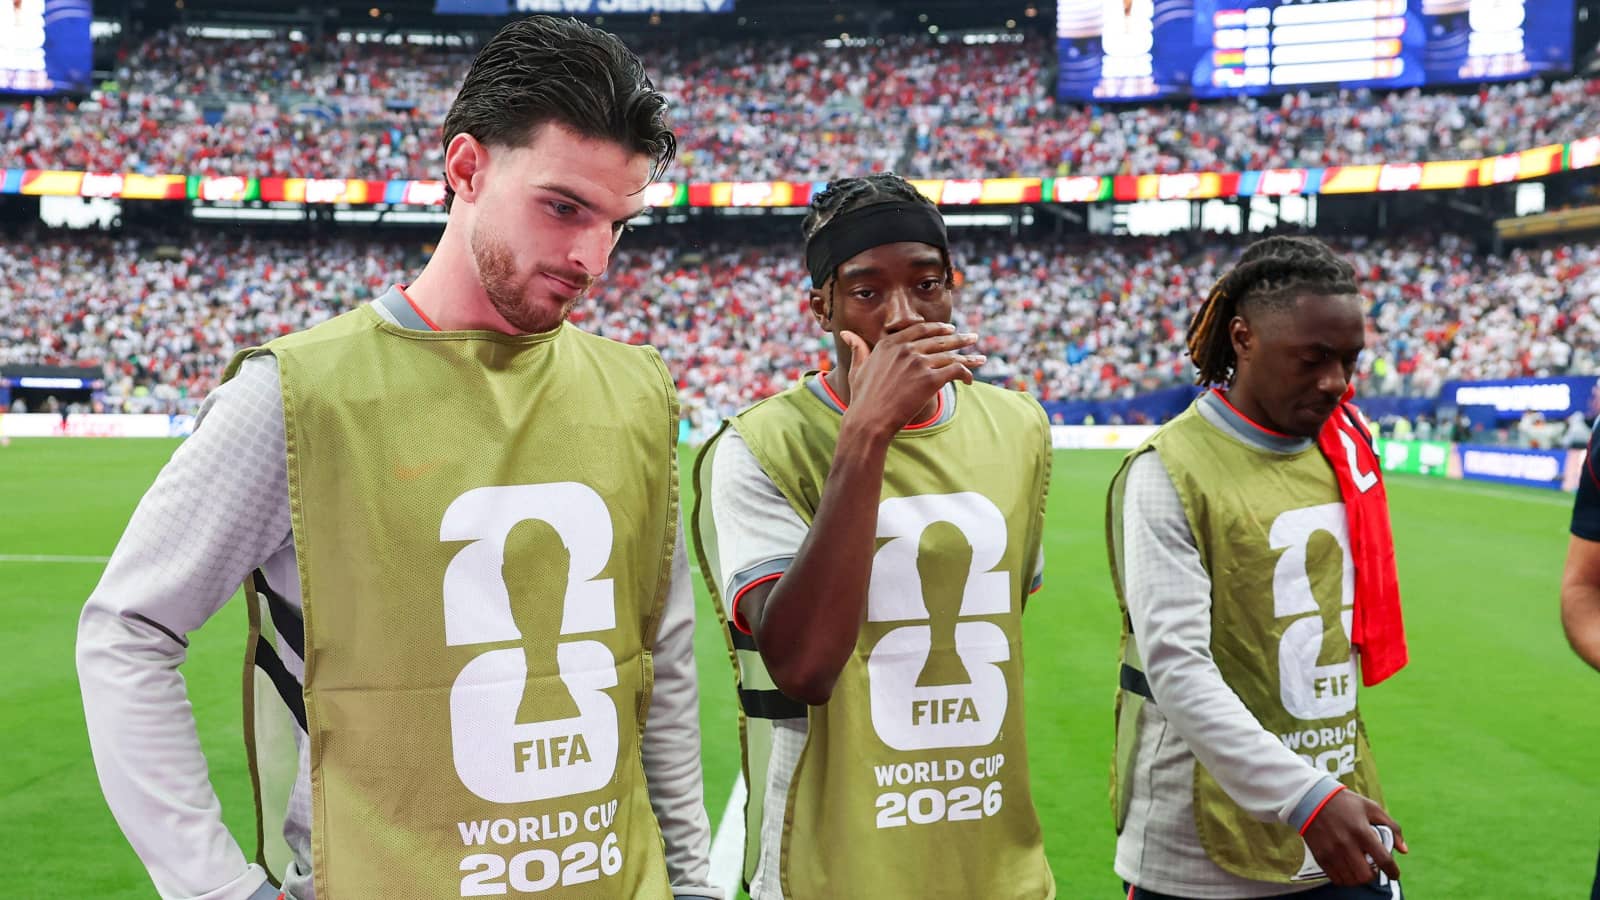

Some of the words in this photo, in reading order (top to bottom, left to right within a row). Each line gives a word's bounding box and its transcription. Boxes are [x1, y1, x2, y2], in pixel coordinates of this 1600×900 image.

[516, 0, 592, 12] NEW
[597, 0, 726, 12] JERSEY
[1313, 674, 1349, 699] FIF
[911, 697, 981, 726] FIFA
[513, 733, 592, 773] FIFA
[874, 759, 965, 787] WORLD
[969, 753, 1005, 780] CUP
[457, 810, 579, 846] WORLD
[582, 799, 618, 831] CUP
[875, 780, 1003, 829] 2026
[458, 831, 623, 897] 2026
